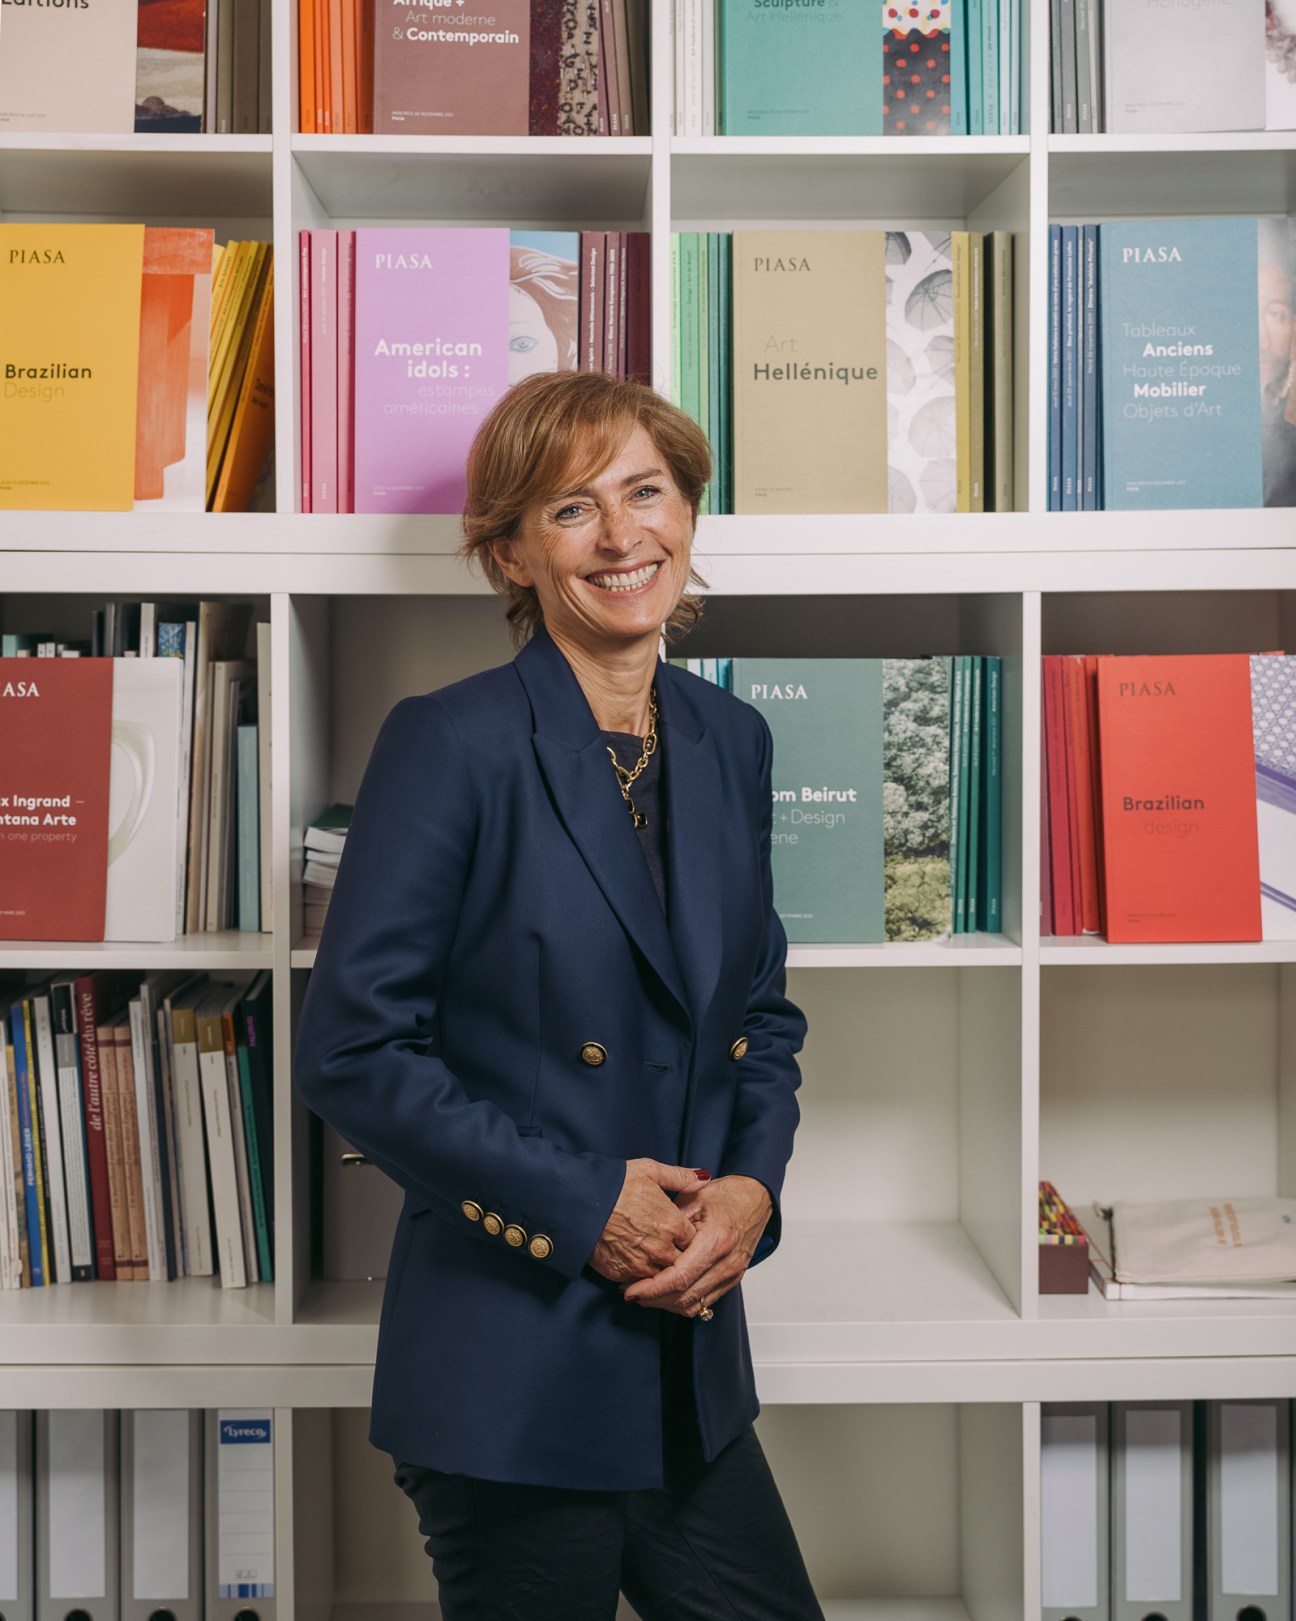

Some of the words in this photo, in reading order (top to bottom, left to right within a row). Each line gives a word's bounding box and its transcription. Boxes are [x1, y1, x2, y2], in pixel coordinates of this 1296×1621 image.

[754, 0, 825, 11] Sculpture
[405, 11, 428, 23] Art
[432, 13, 496, 25] moderne
[392, 27, 403, 40] &
[406, 28, 519, 45] Contemporain
[8, 250, 66, 264] PIASA
[375, 254, 433, 269] PIASA
[1122, 247, 1182, 263] PIASA
[754, 257, 811, 272] PIASA
[1122, 323, 1196, 338] Tableaux
[373, 338, 483, 356] American
[764, 335, 799, 353] Art
[1142, 342, 1213, 358] Anciens
[5, 364, 92, 379] Brazilian
[407, 361, 459, 378] idols
[753, 361, 879, 386] Hellénique
[1122, 363, 1174, 378] Haute
[1179, 359, 1242, 381] Époque
[4, 383, 65, 402] Design
[418, 385, 495, 401] estampes
[1133, 382, 1206, 398] Mobilier
[383, 401, 478, 415] américaines
[1123, 403, 1178, 422] Objets
[1184, 402, 1222, 418] d'Art
[0, 682, 40, 697] ASA
[750, 684, 809, 700] PIASA
[1119, 682, 1177, 697] PIASA
[13, 795, 71, 810] Ingrand
[772, 790, 797, 802] om
[801, 787, 857, 802] Beirut
[1123, 795, 1205, 811] Brazilian
[0, 814, 39, 826] tana
[43, 813, 77, 826] Arte
[791, 809, 846, 828] Design
[1144, 819, 1199, 838] design
[8, 833, 28, 841] one
[31, 832, 78, 844] property
[771, 832, 799, 844] ene
[81, 992, 93, 1022] rêve
[82, 1024, 95, 1042] du
[84, 1043, 97, 1070] côté
[87, 1071, 101, 1112] l'autre
[90, 1114, 102, 1131] de
